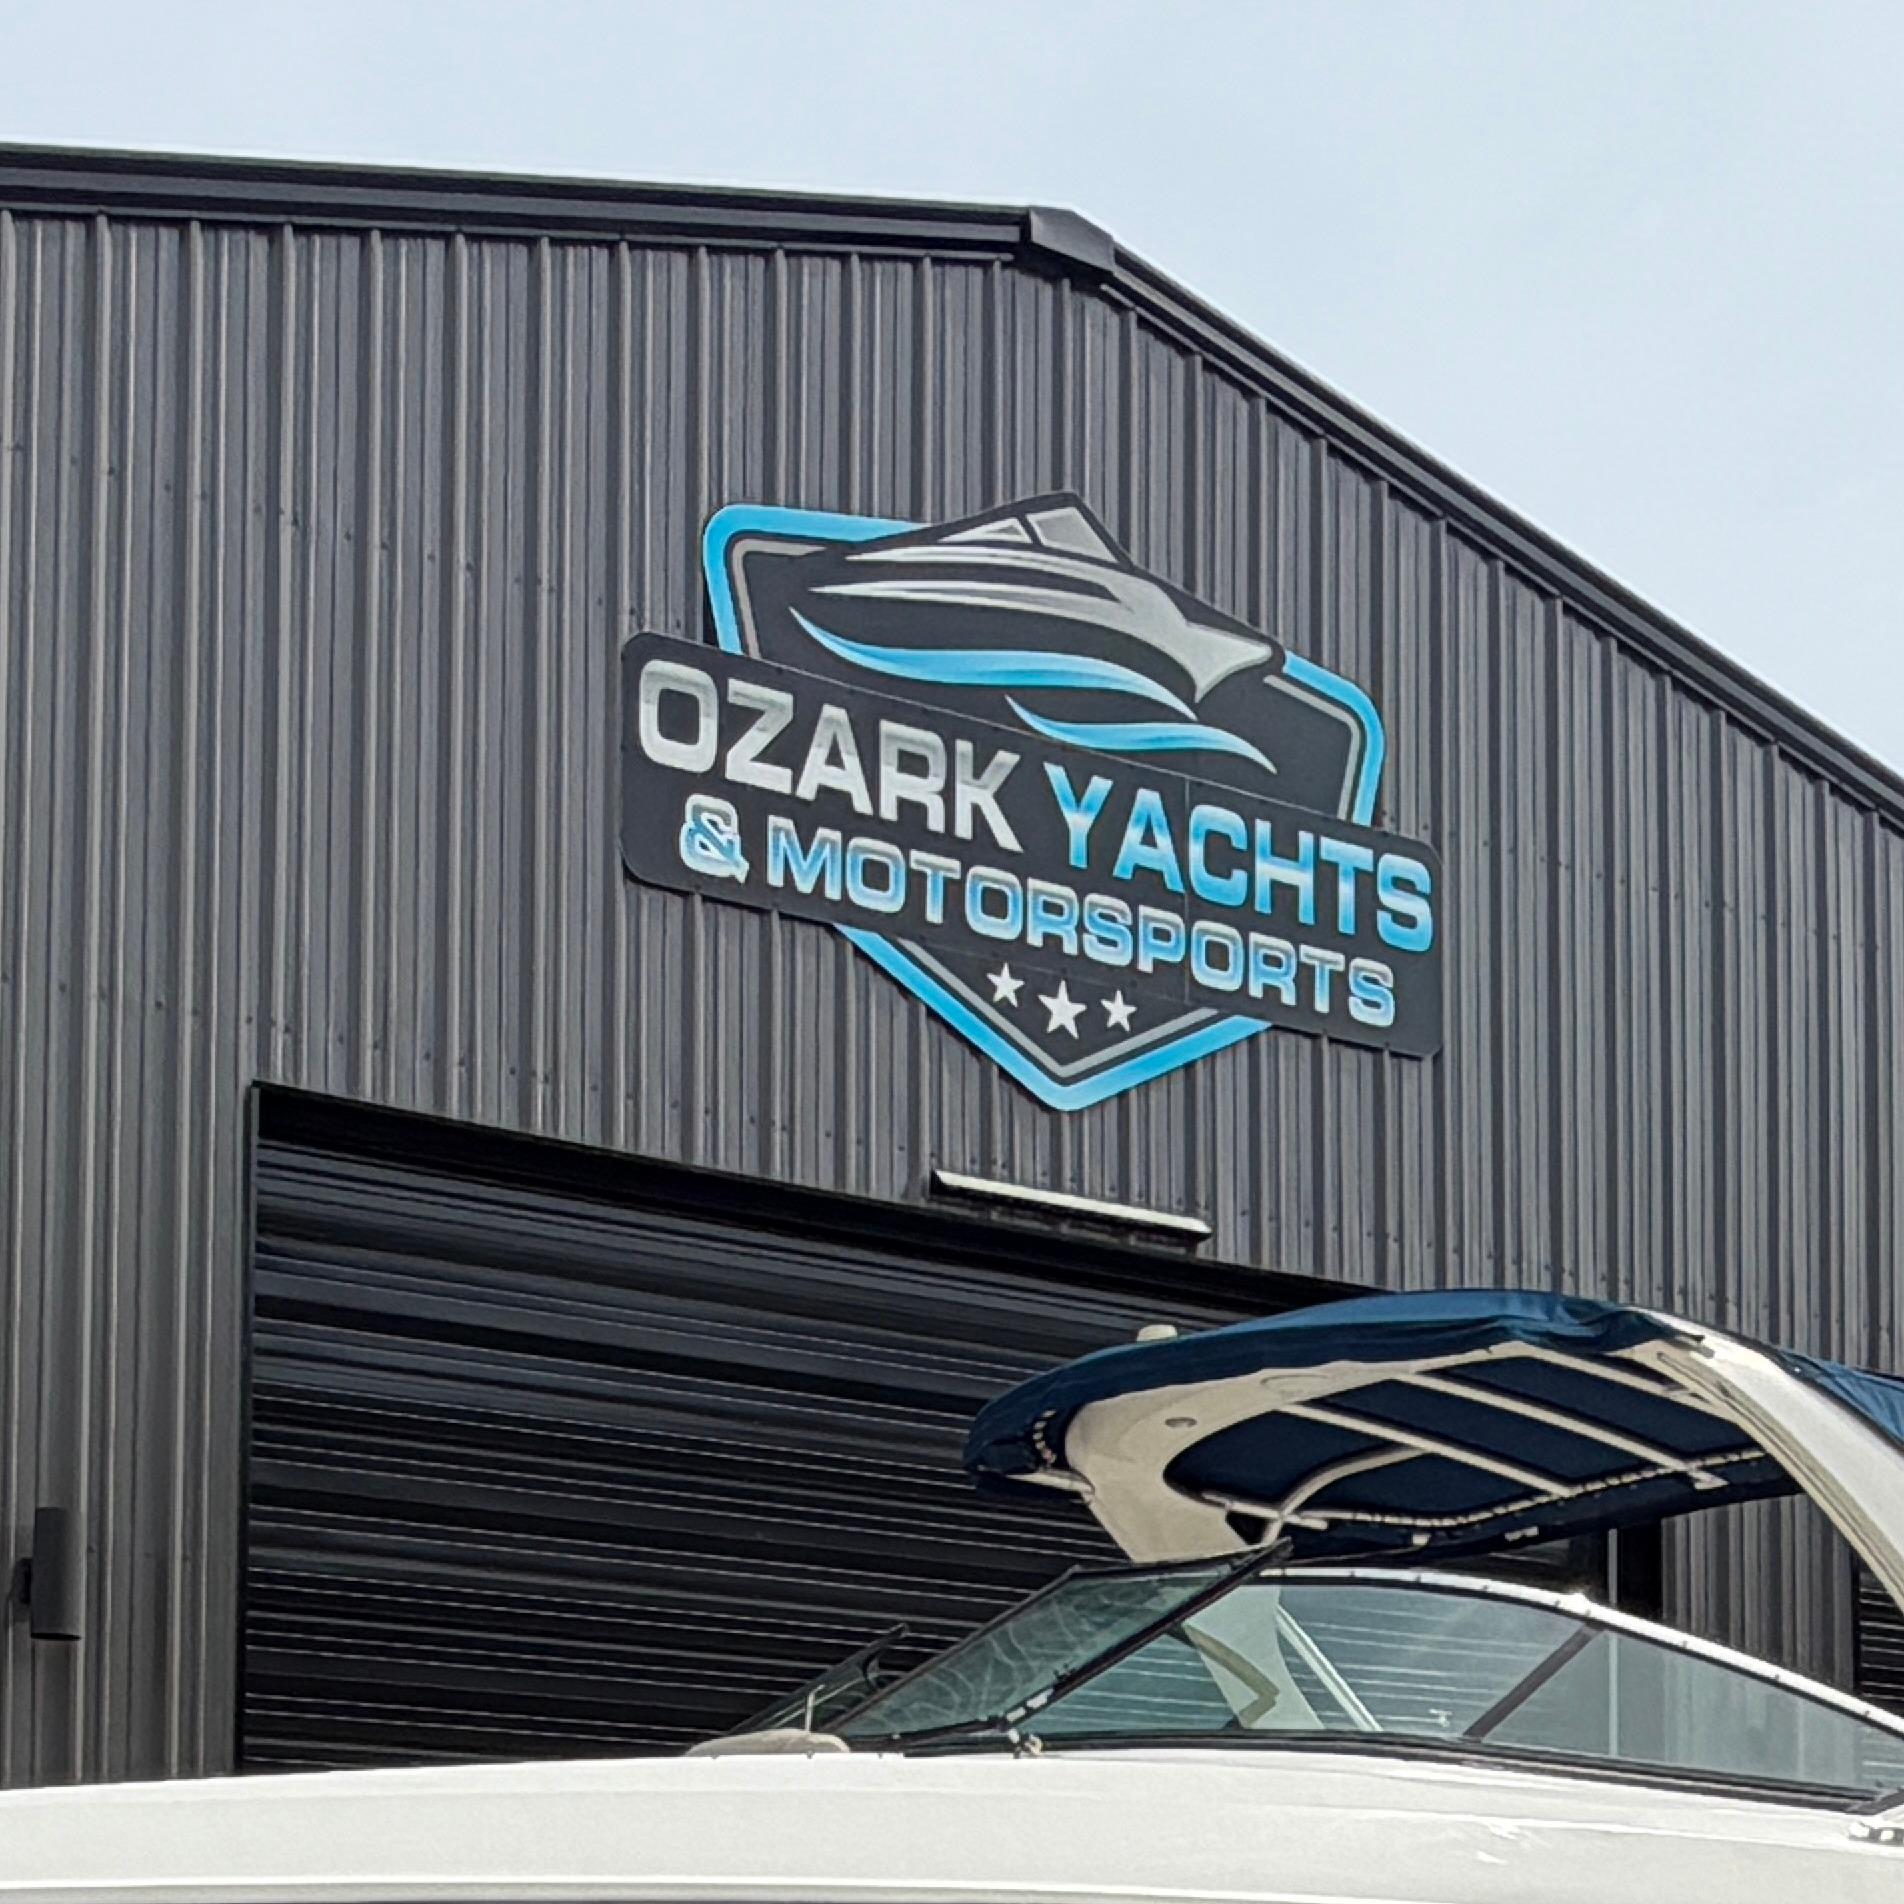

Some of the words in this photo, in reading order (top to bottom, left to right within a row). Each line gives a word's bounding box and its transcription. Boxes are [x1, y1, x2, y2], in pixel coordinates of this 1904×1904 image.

[637, 659, 1022, 853] OZARK
[1043, 761, 1435, 953] YACHTS
[679, 795, 749, 883] &
[767, 816, 1396, 1028] MOTORSPORTS
